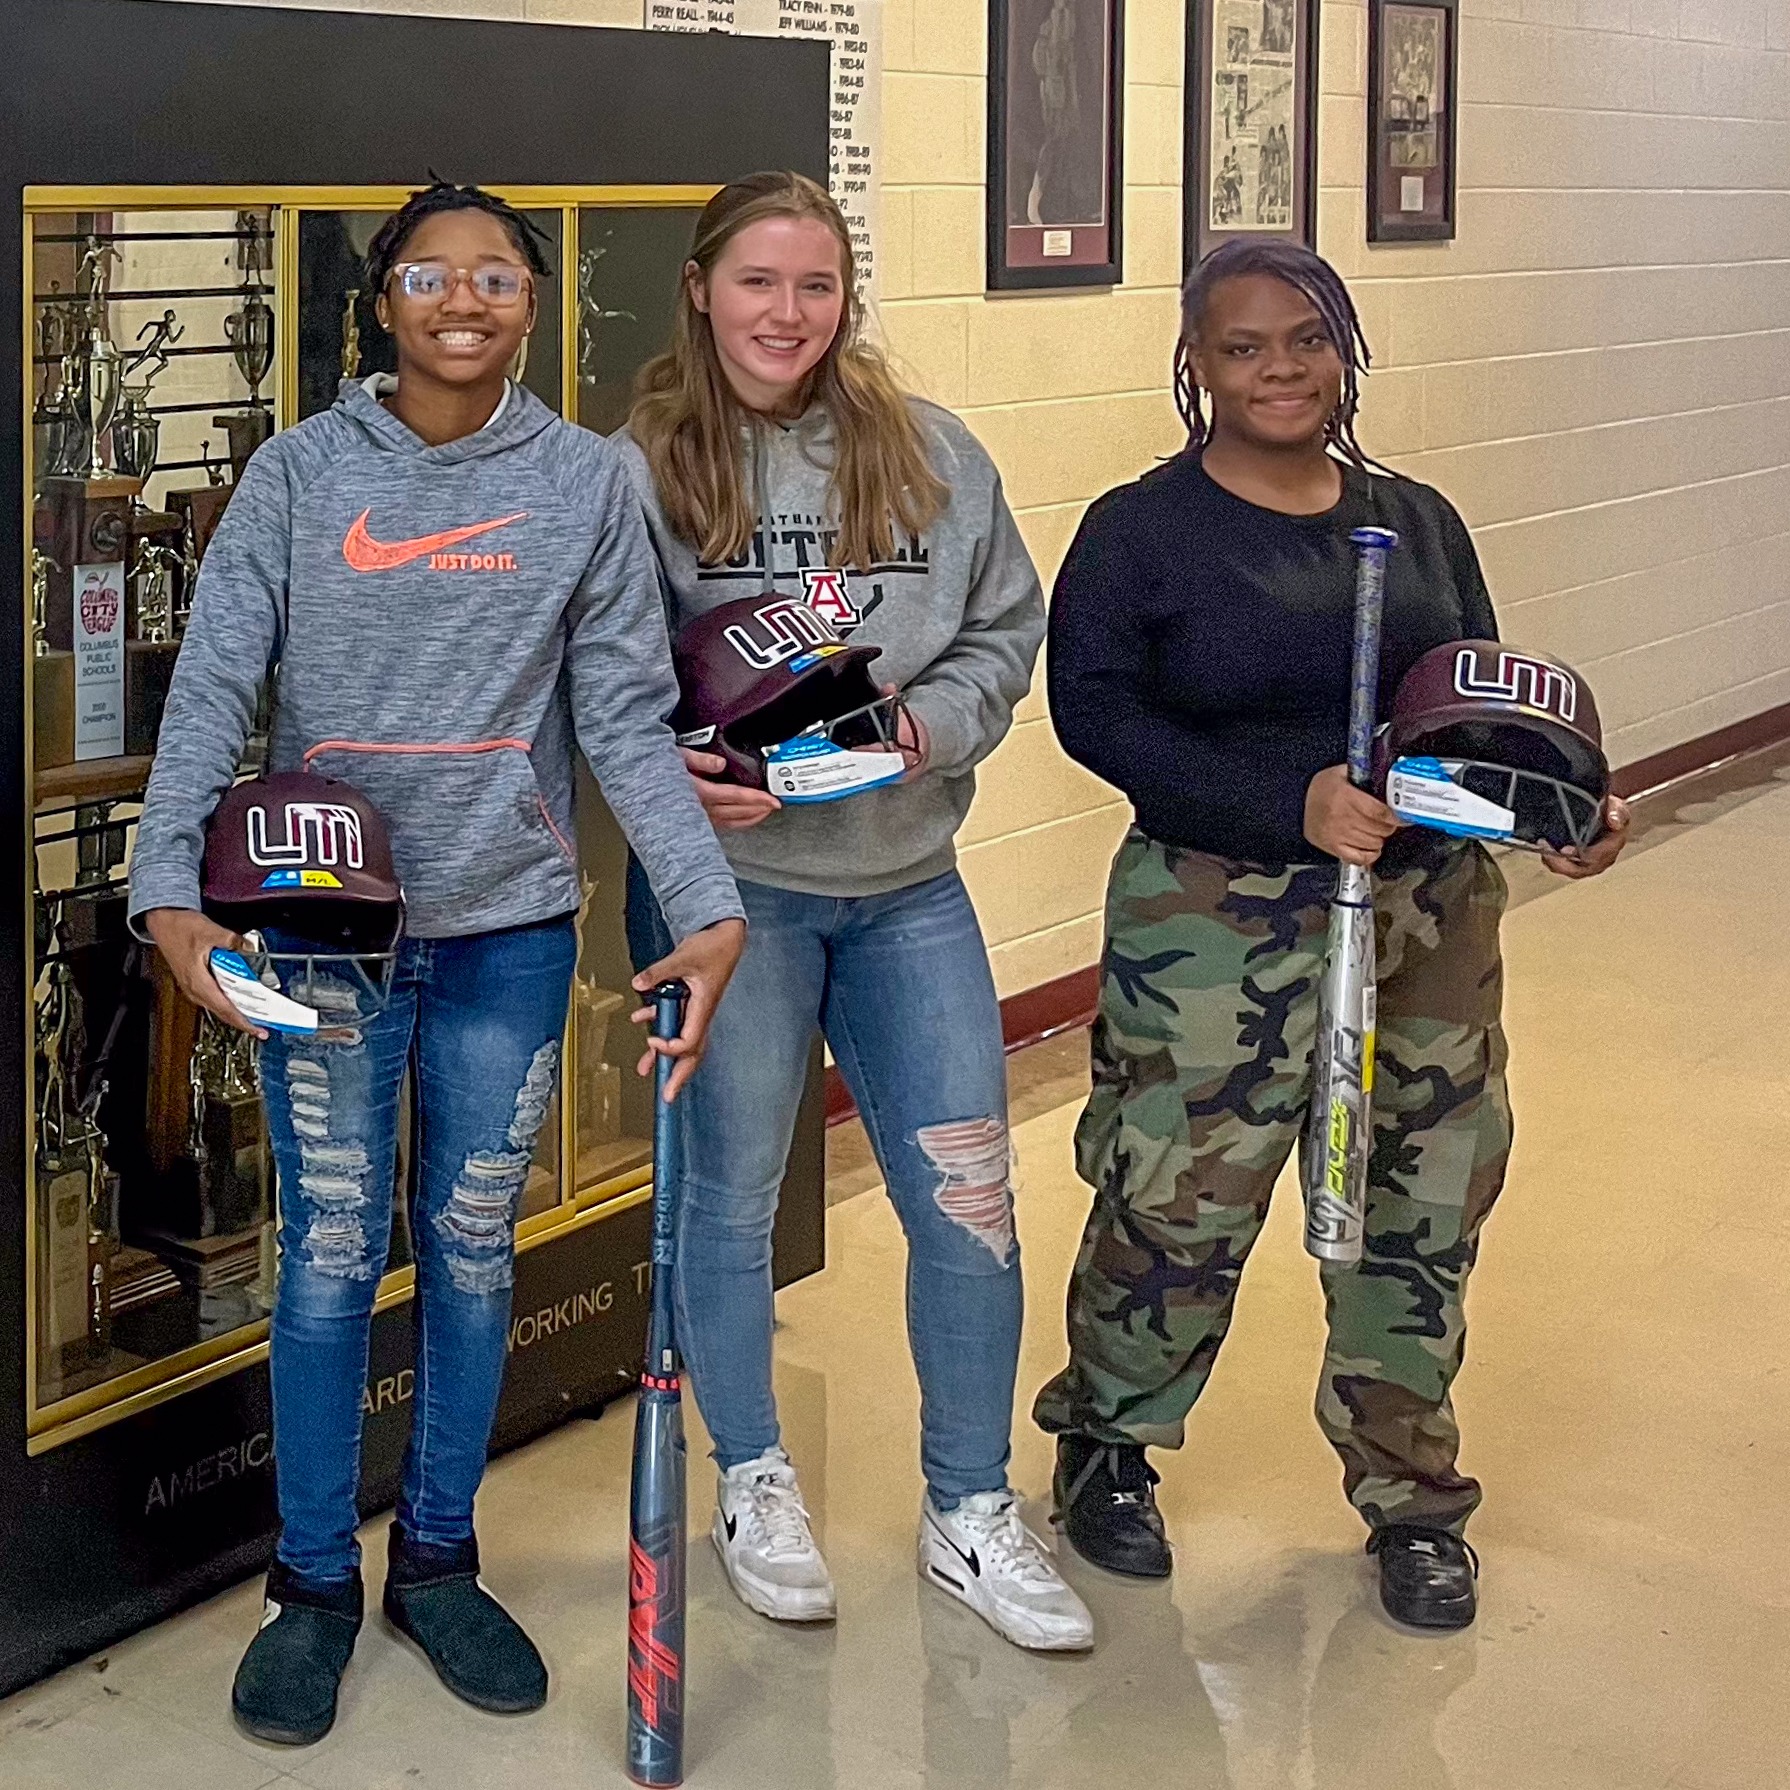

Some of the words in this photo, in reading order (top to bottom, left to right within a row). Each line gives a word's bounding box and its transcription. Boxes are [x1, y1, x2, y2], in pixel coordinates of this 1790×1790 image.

[428, 554, 469, 570] JUST
[470, 554, 496, 570] DO
[80, 602, 119, 619] CITY
[82, 664, 116, 677] SCHOOLS
[145, 1432, 276, 1516] AMERIC
[362, 1368, 415, 1414] ARD
